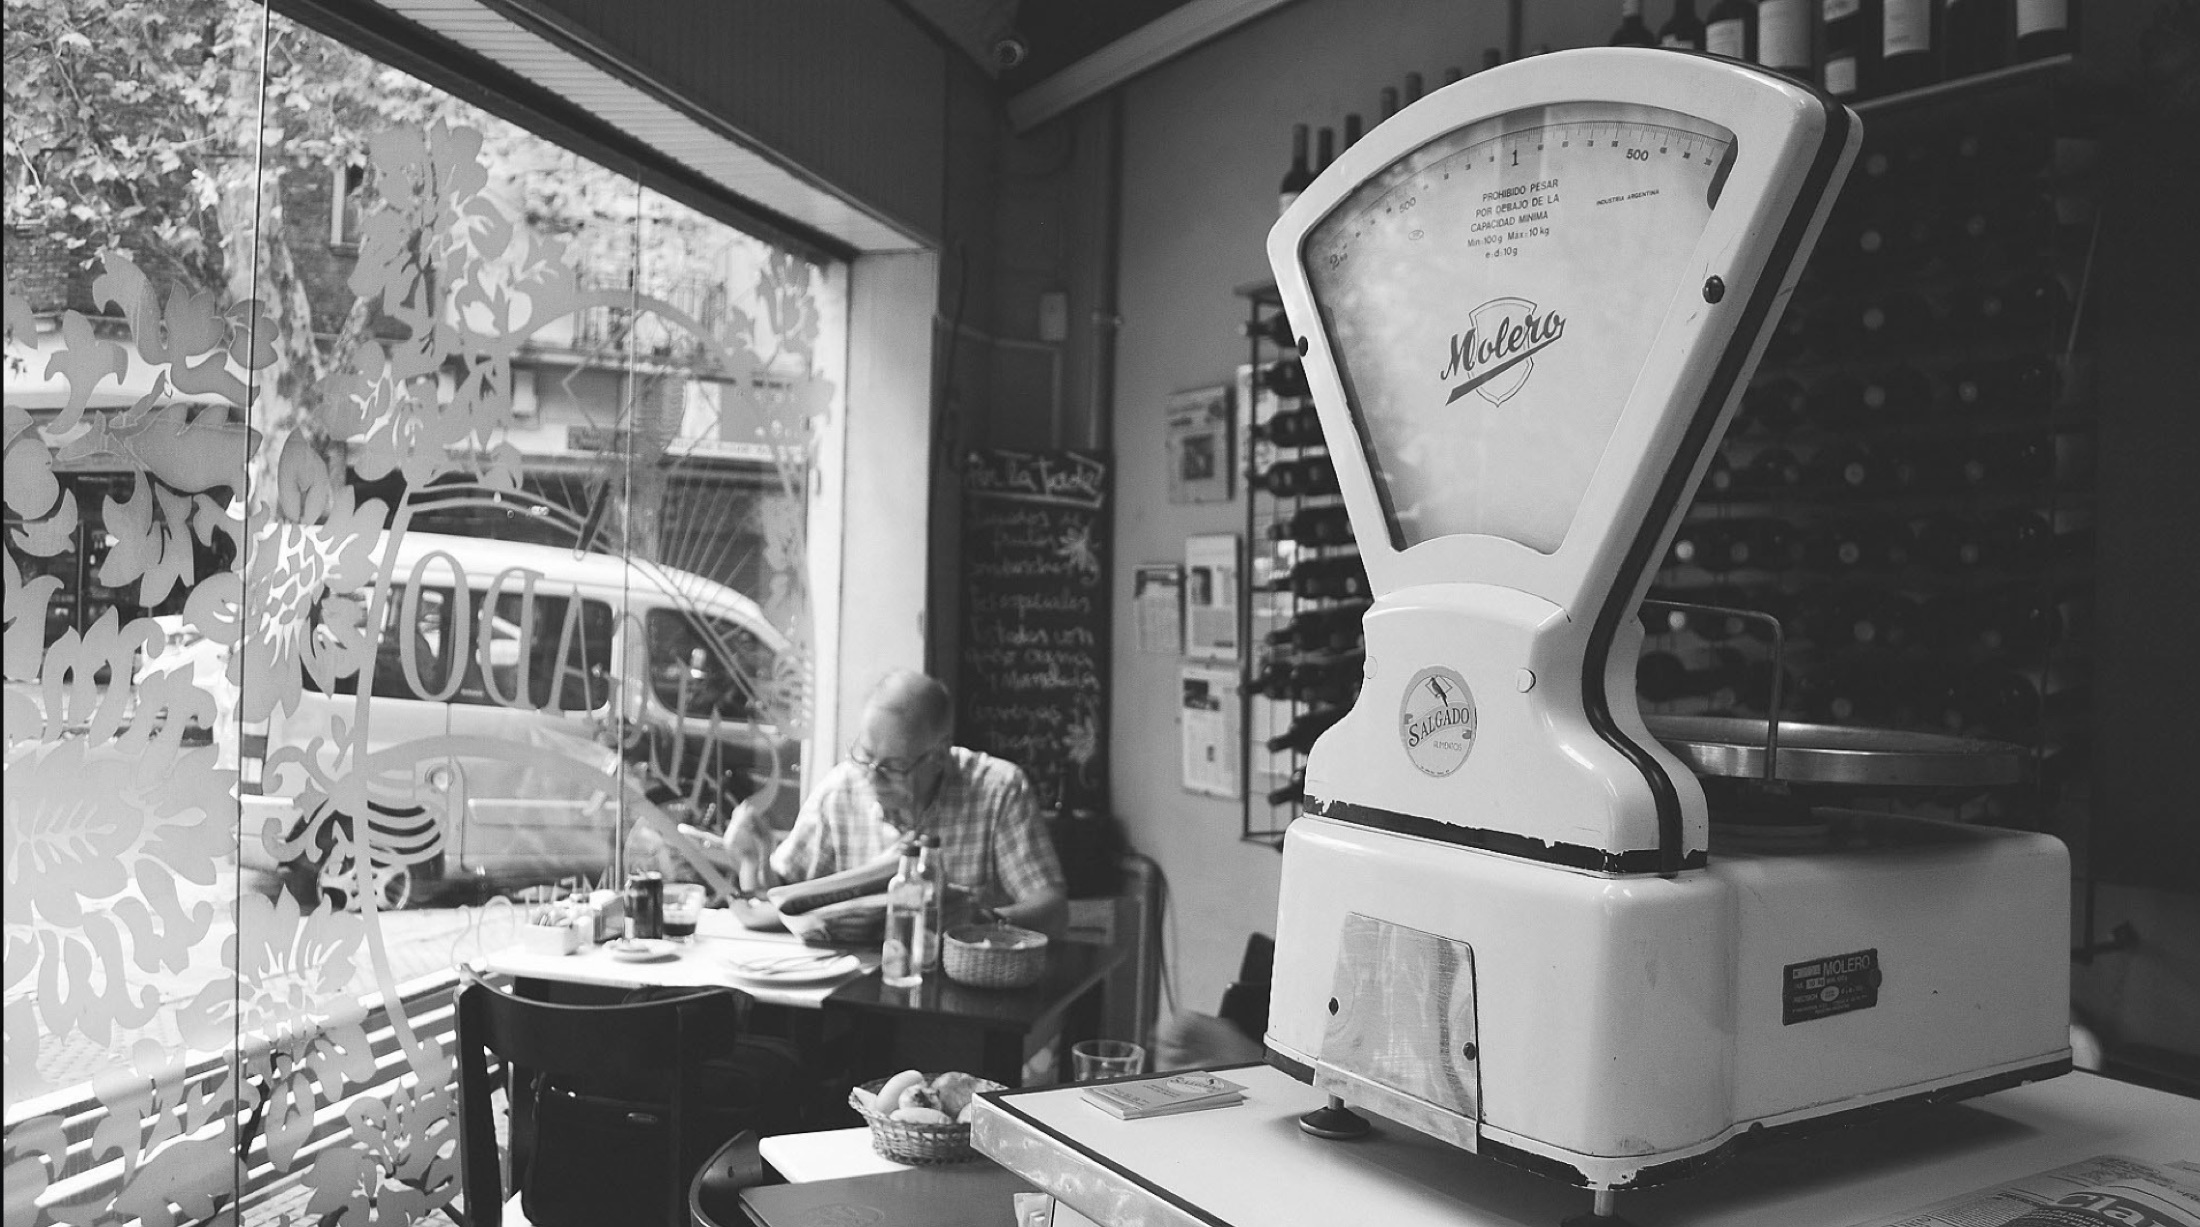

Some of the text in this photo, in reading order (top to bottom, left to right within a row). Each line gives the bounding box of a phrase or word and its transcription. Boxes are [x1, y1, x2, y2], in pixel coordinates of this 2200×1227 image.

[1510, 149, 1519, 167] 1
[1625, 147, 1649, 163] 500
[1482, 178, 1558, 202] PROHIBIDO PESAR
[1596, 188, 1660, 206] INDUSTRIA ARGENTINA
[1399, 196, 1417, 214] 500
[1475, 193, 1559, 218] POR DEBAJO DE LA
[1470, 216, 1516, 232] CAPACIDAD
[1440, 308, 1567, 382] Molero
[1408, 707, 1470, 748] SALGADO
[1824, 954, 1871, 976] MOLERO
